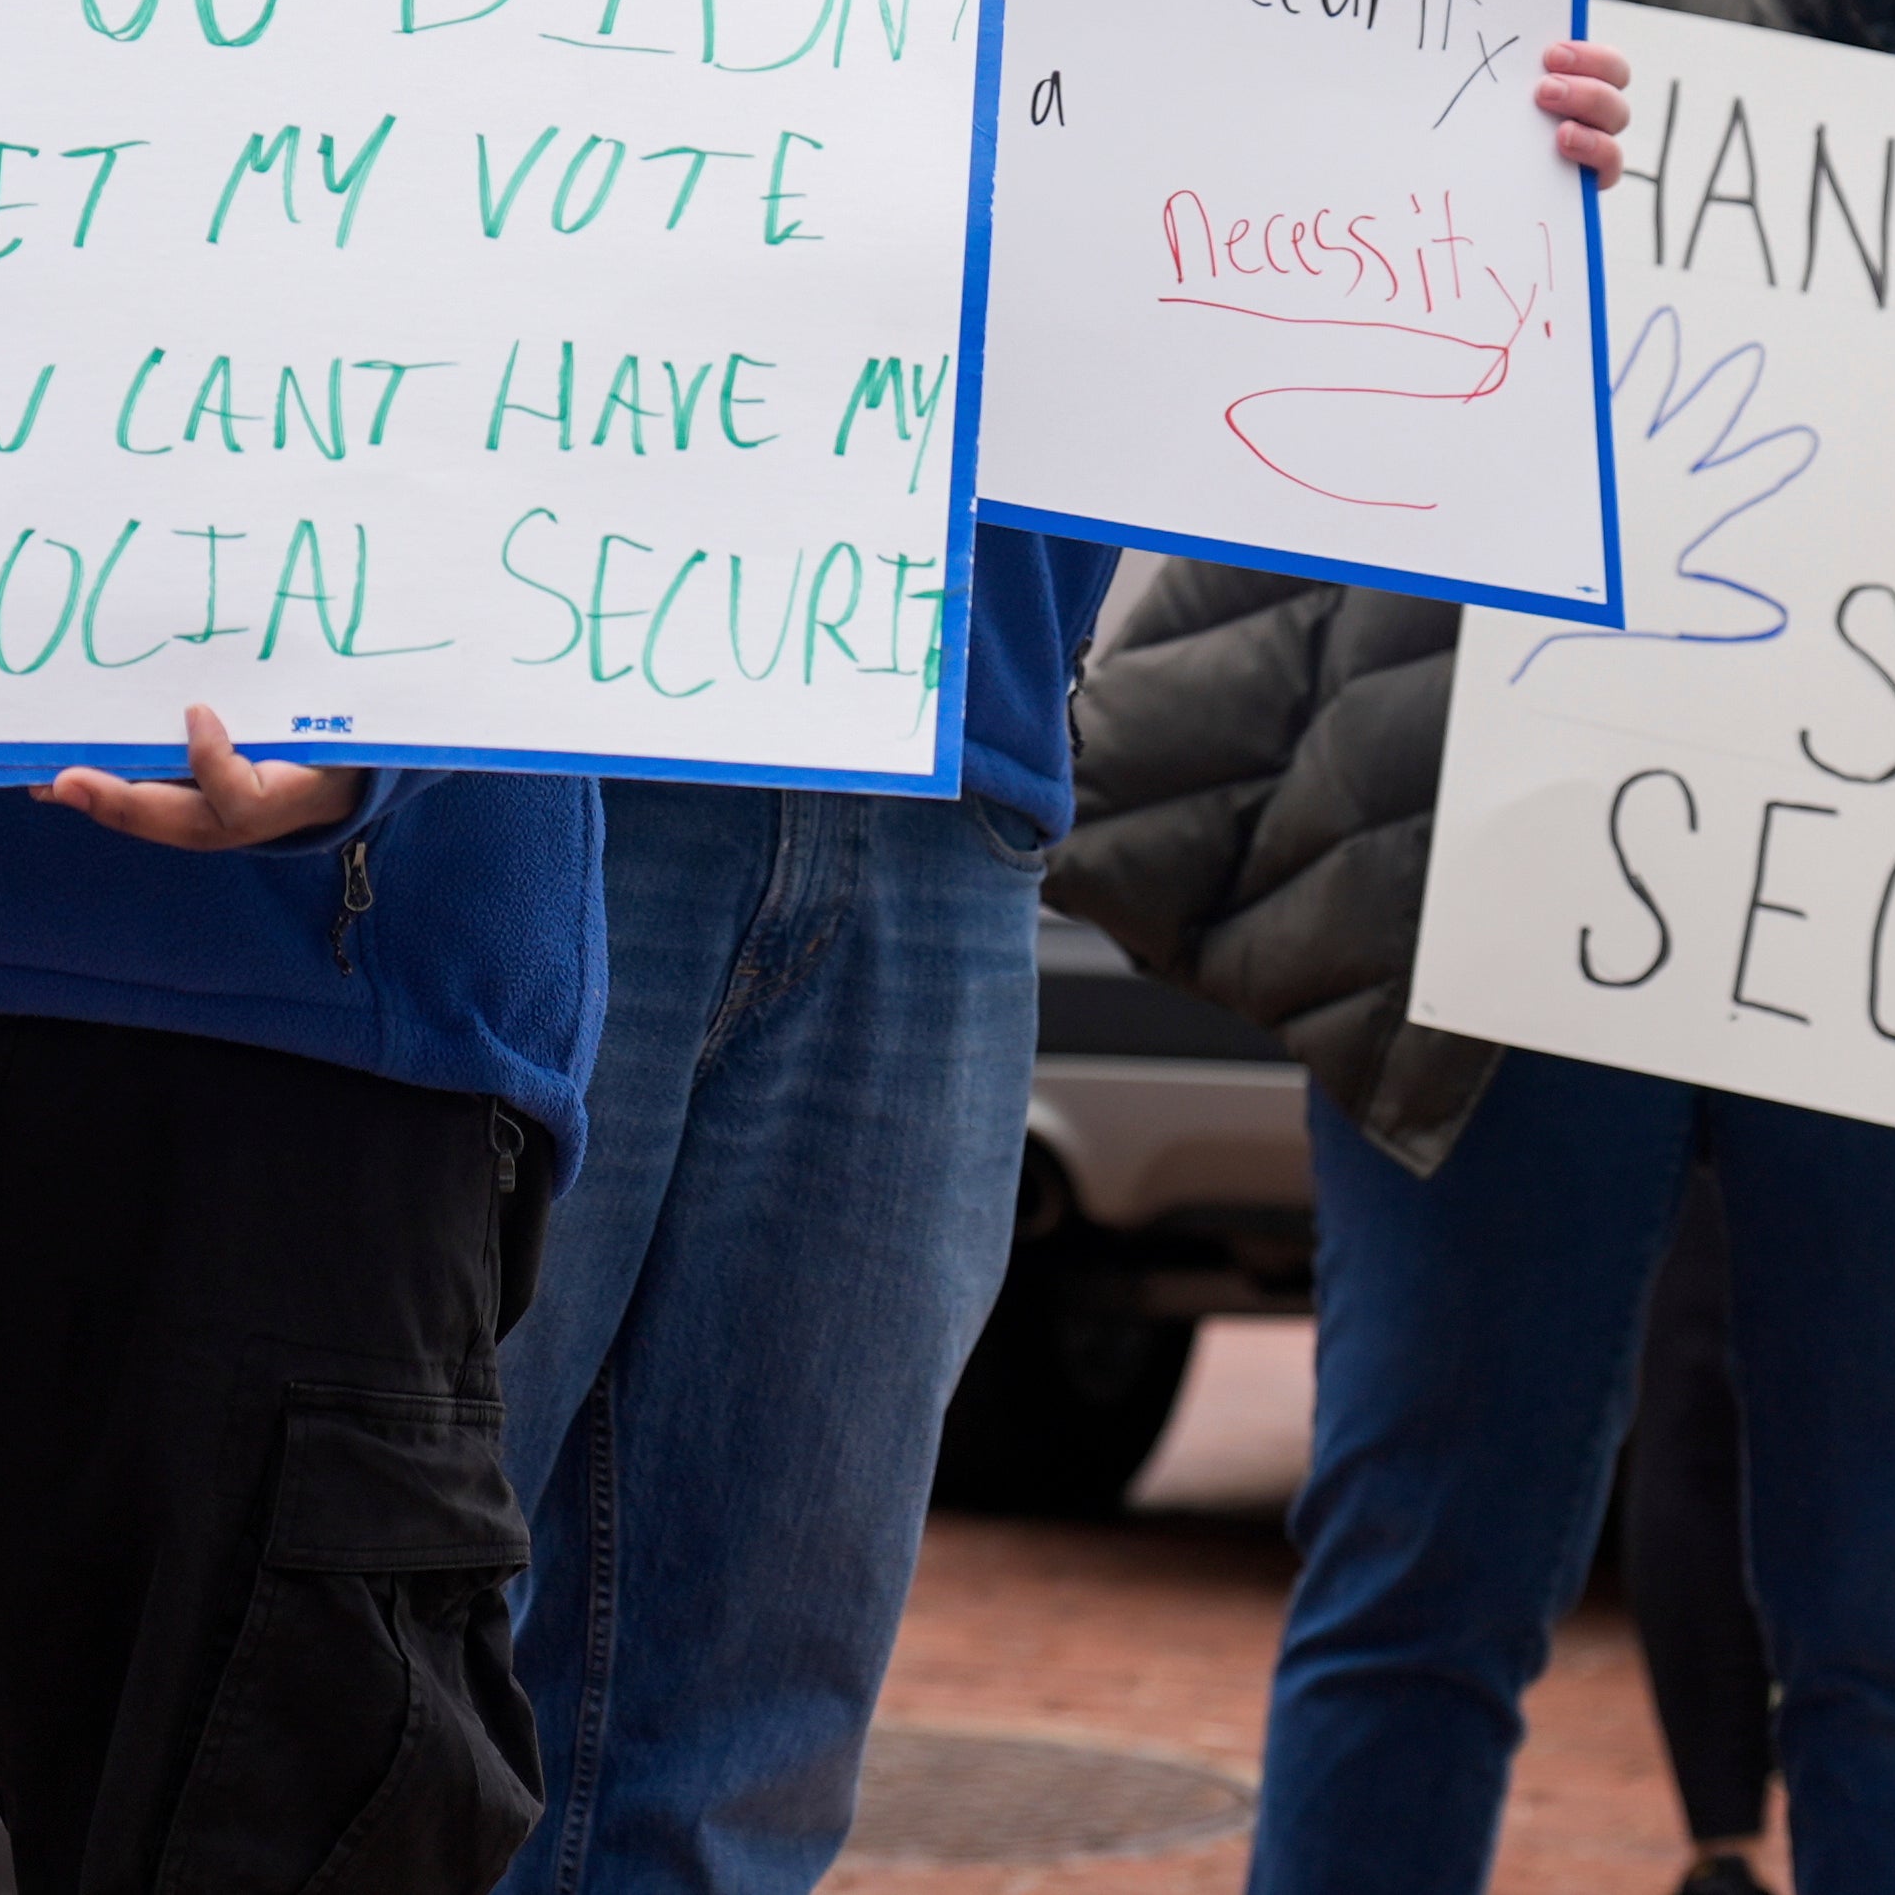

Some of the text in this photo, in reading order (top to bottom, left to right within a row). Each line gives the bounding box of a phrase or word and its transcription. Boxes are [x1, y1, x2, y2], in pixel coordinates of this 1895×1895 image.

[1030, 70, 1066, 128] a
[208, 113, 396, 249] MY
[476, 127, 826, 246] VOTE
[1162, 188, 1556, 406] necessity!
[116, 348, 458, 462] CANT
[486, 340, 780, 456] HAVE
[833, 354, 950, 494] MY
